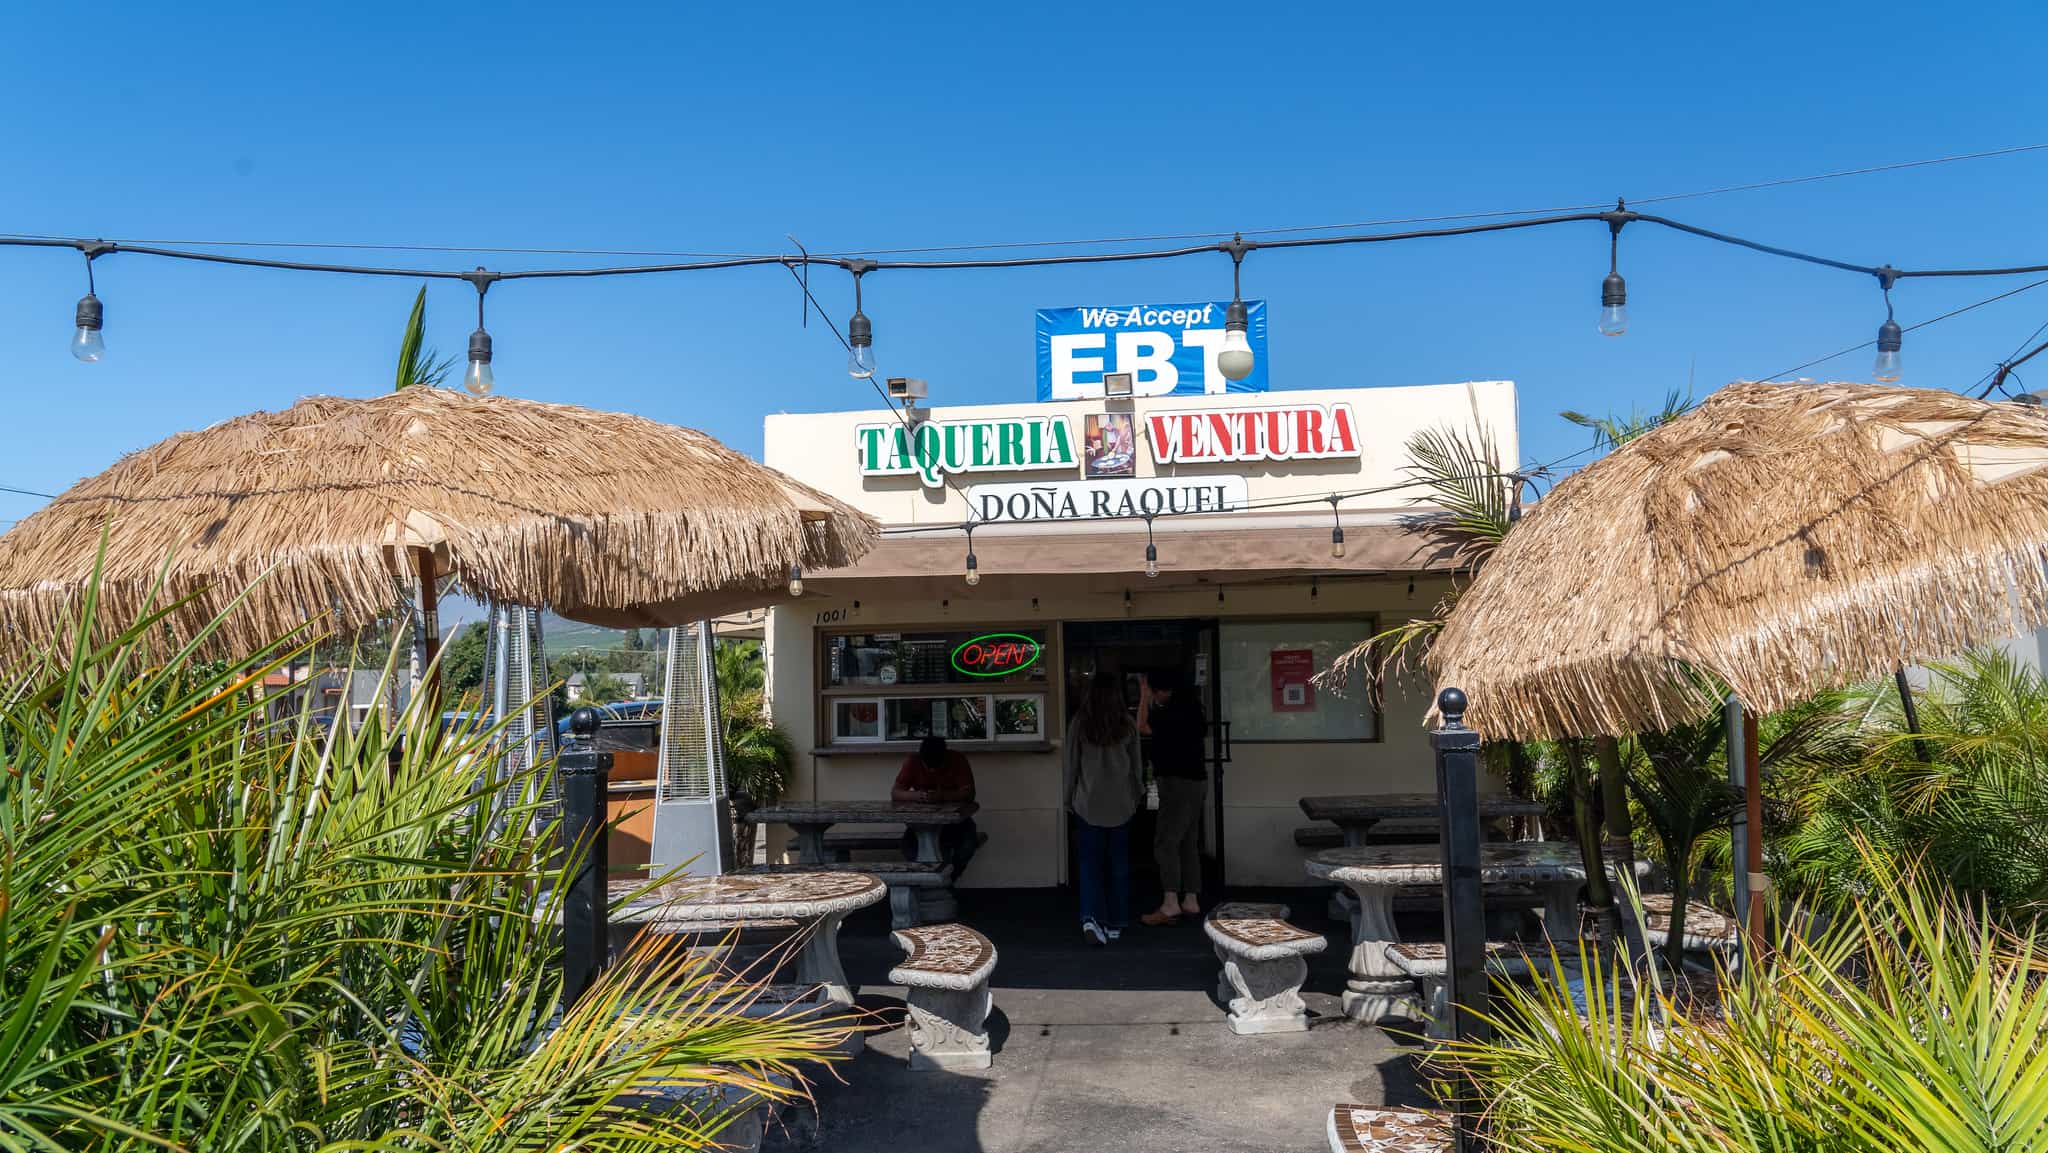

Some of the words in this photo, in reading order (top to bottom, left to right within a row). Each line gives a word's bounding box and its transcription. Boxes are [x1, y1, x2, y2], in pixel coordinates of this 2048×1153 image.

[1081, 307, 1119, 329] We
[1124, 304, 1212, 329] Accept
[1050, 329, 1240, 400] EBT
[860, 420, 1073, 482] TAQUERIA
[1149, 408, 1356, 458] VENTURA
[980, 487, 1081, 521] DOÑA
[1090, 485, 1235, 519] RAQUEL
[816, 608, 848, 624] 1001
[962, 643, 1027, 666] OPEN
